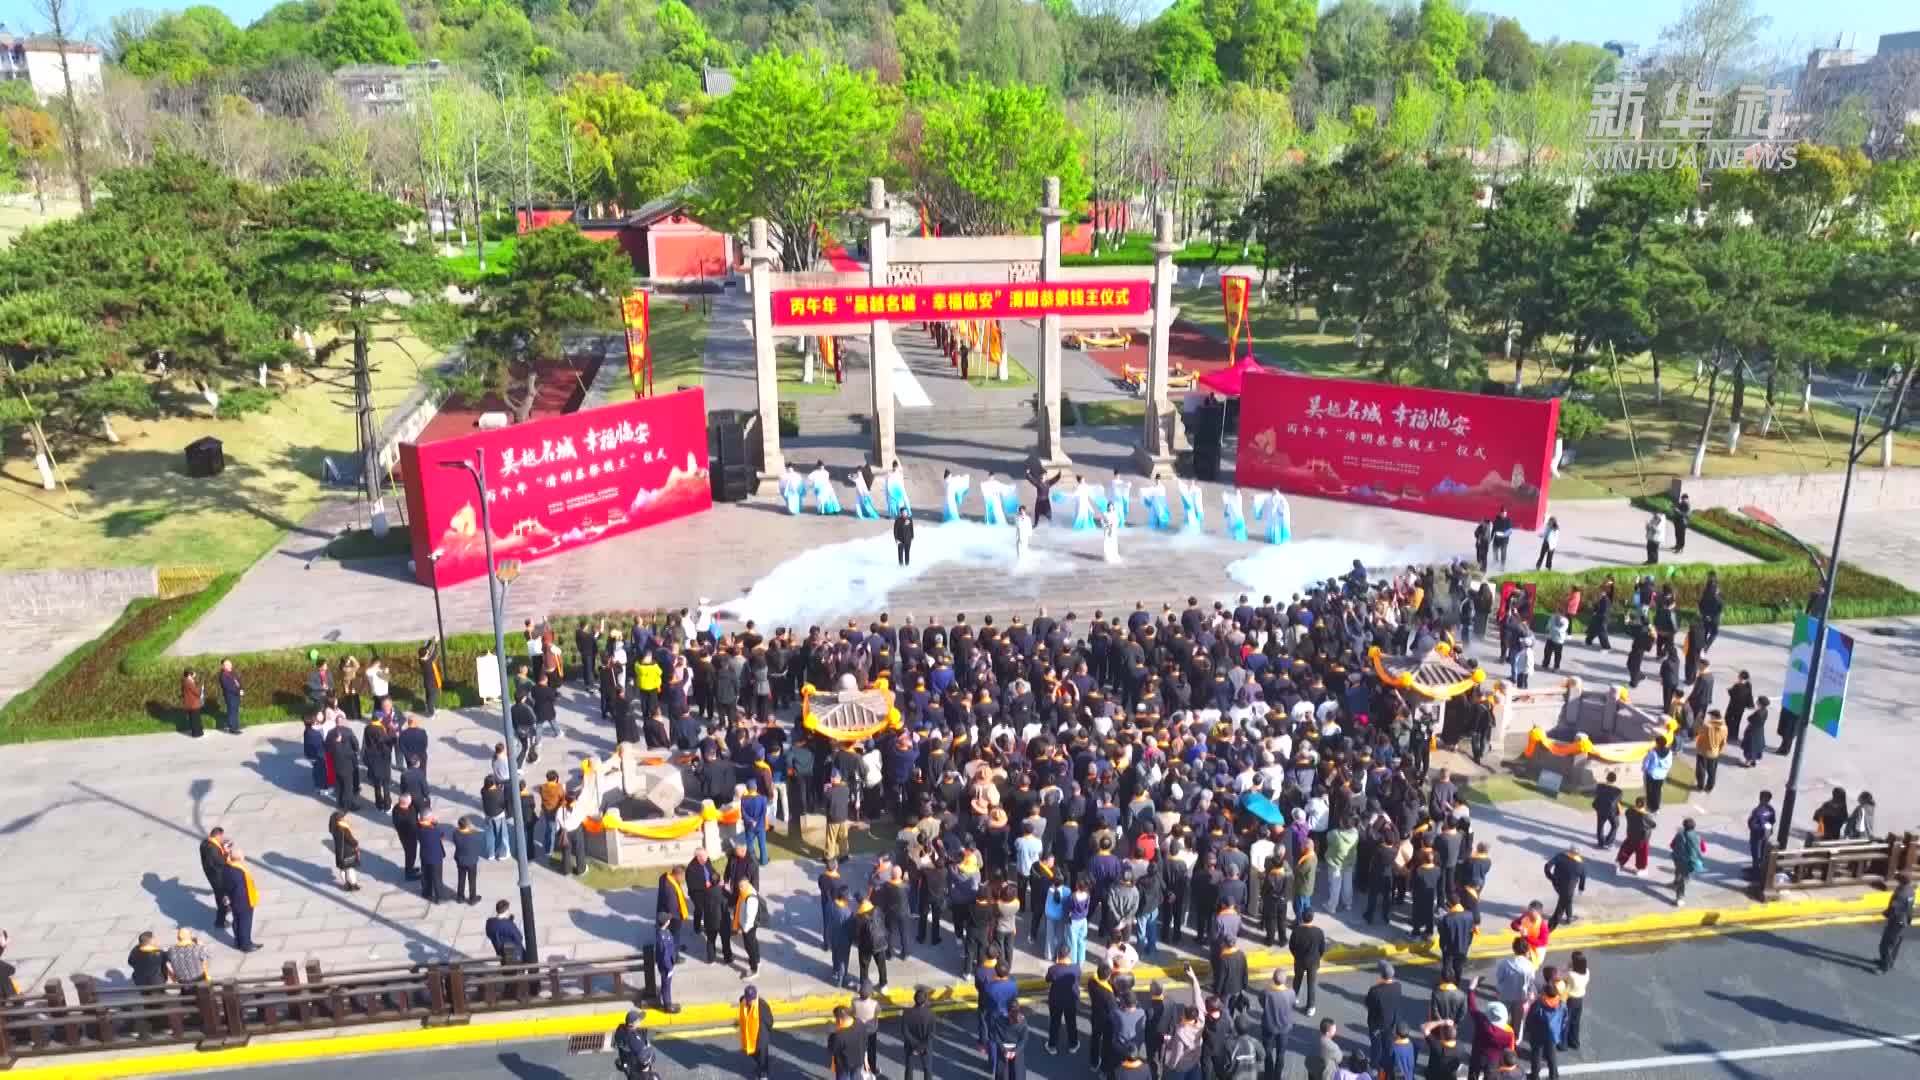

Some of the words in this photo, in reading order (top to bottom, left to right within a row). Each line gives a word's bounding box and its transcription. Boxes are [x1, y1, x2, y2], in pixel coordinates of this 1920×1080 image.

[1304, 395, 1383, 425] 吴越名城
[1391, 400, 1472, 437] 幸福临安
[499, 436, 578, 477] 吴越名城
[583, 420, 651, 454] 幸福临安
